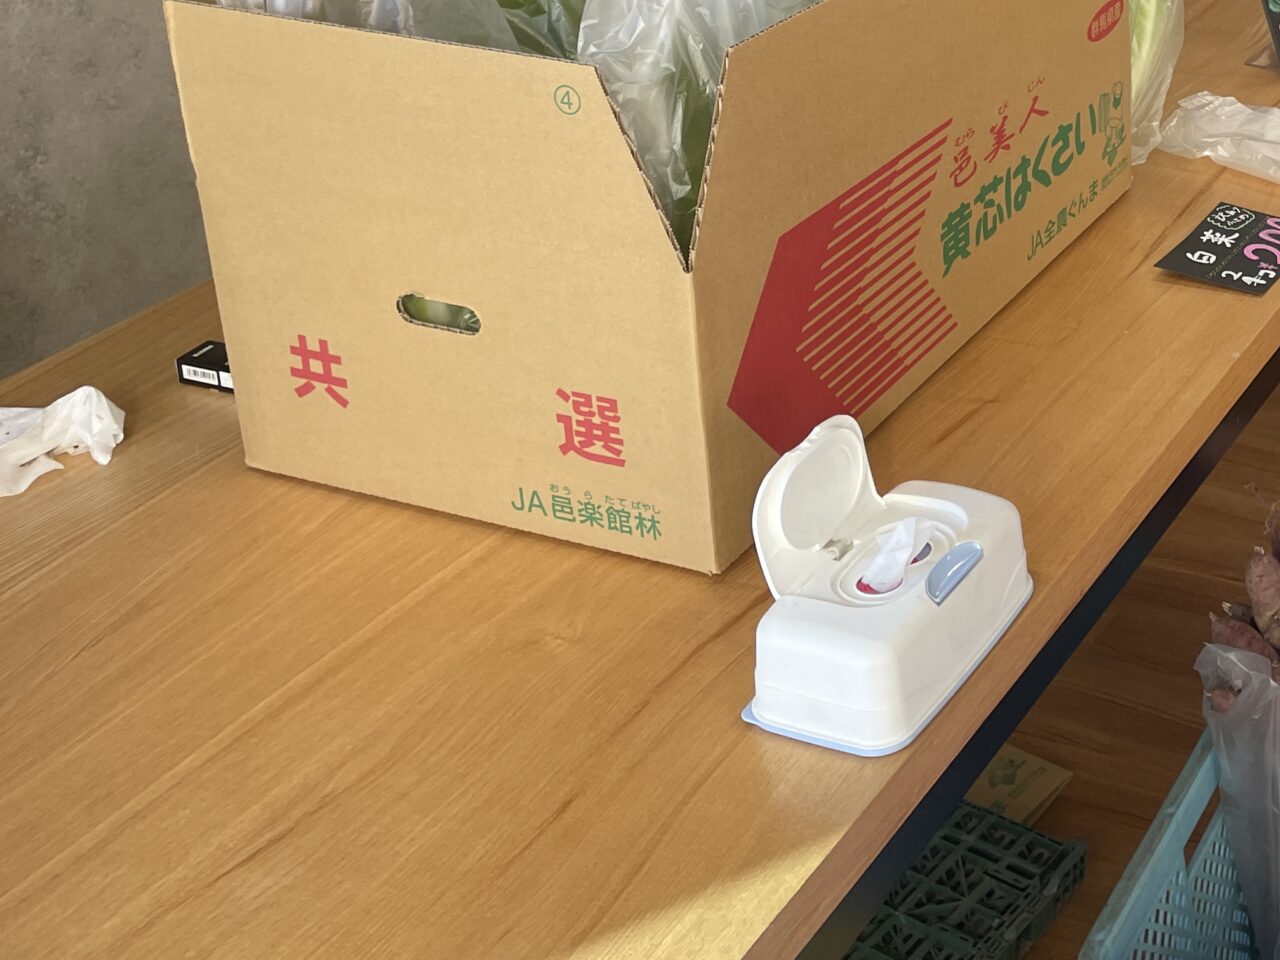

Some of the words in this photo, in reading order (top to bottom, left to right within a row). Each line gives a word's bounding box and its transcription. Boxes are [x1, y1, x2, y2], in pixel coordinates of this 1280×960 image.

[940, 102, 1098, 280] 黄芯はくさい
[1027, 179, 1099, 261] JA全農ぐんま
[1186, 228, 1240, 265] 白菜
[511, 486, 662, 541] JA邑楽館林
